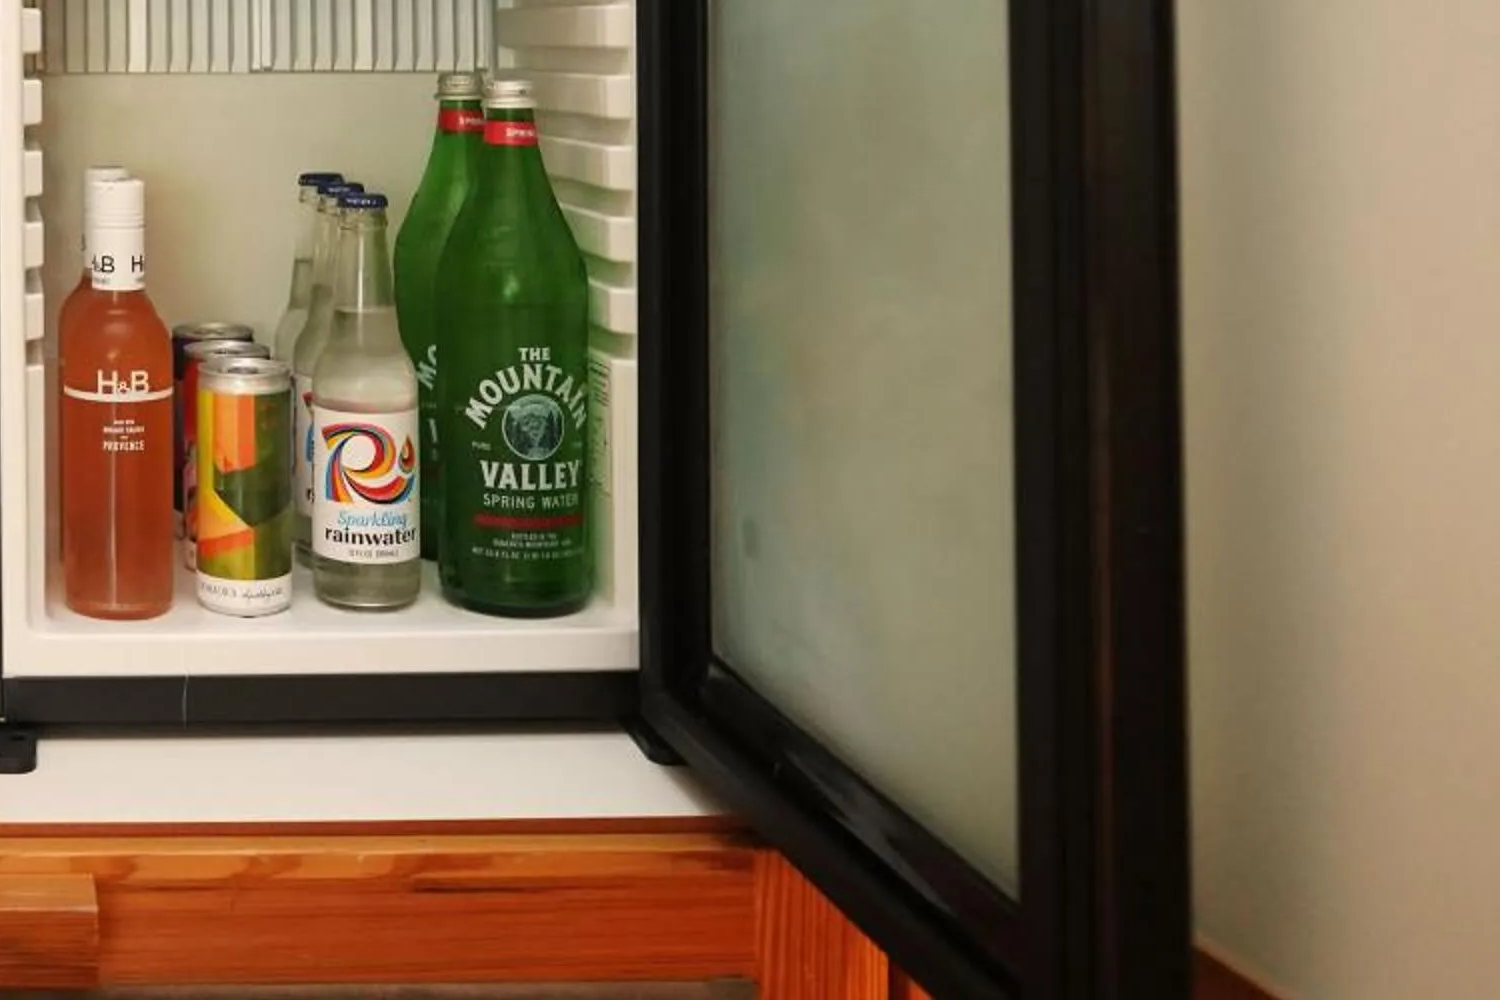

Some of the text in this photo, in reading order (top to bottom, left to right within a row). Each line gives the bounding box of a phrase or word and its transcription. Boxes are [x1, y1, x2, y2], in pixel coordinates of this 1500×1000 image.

[518, 347, 551, 361] THE
[97, 369, 150, 395] H&B
[465, 363, 587, 430] MOUNTAIN
[480, 459, 581, 491] VALLEY
[483, 493, 579, 509] SPRING WATER
[337, 510, 407, 528] Sparkling
[325, 526, 417, 545] rainwater
